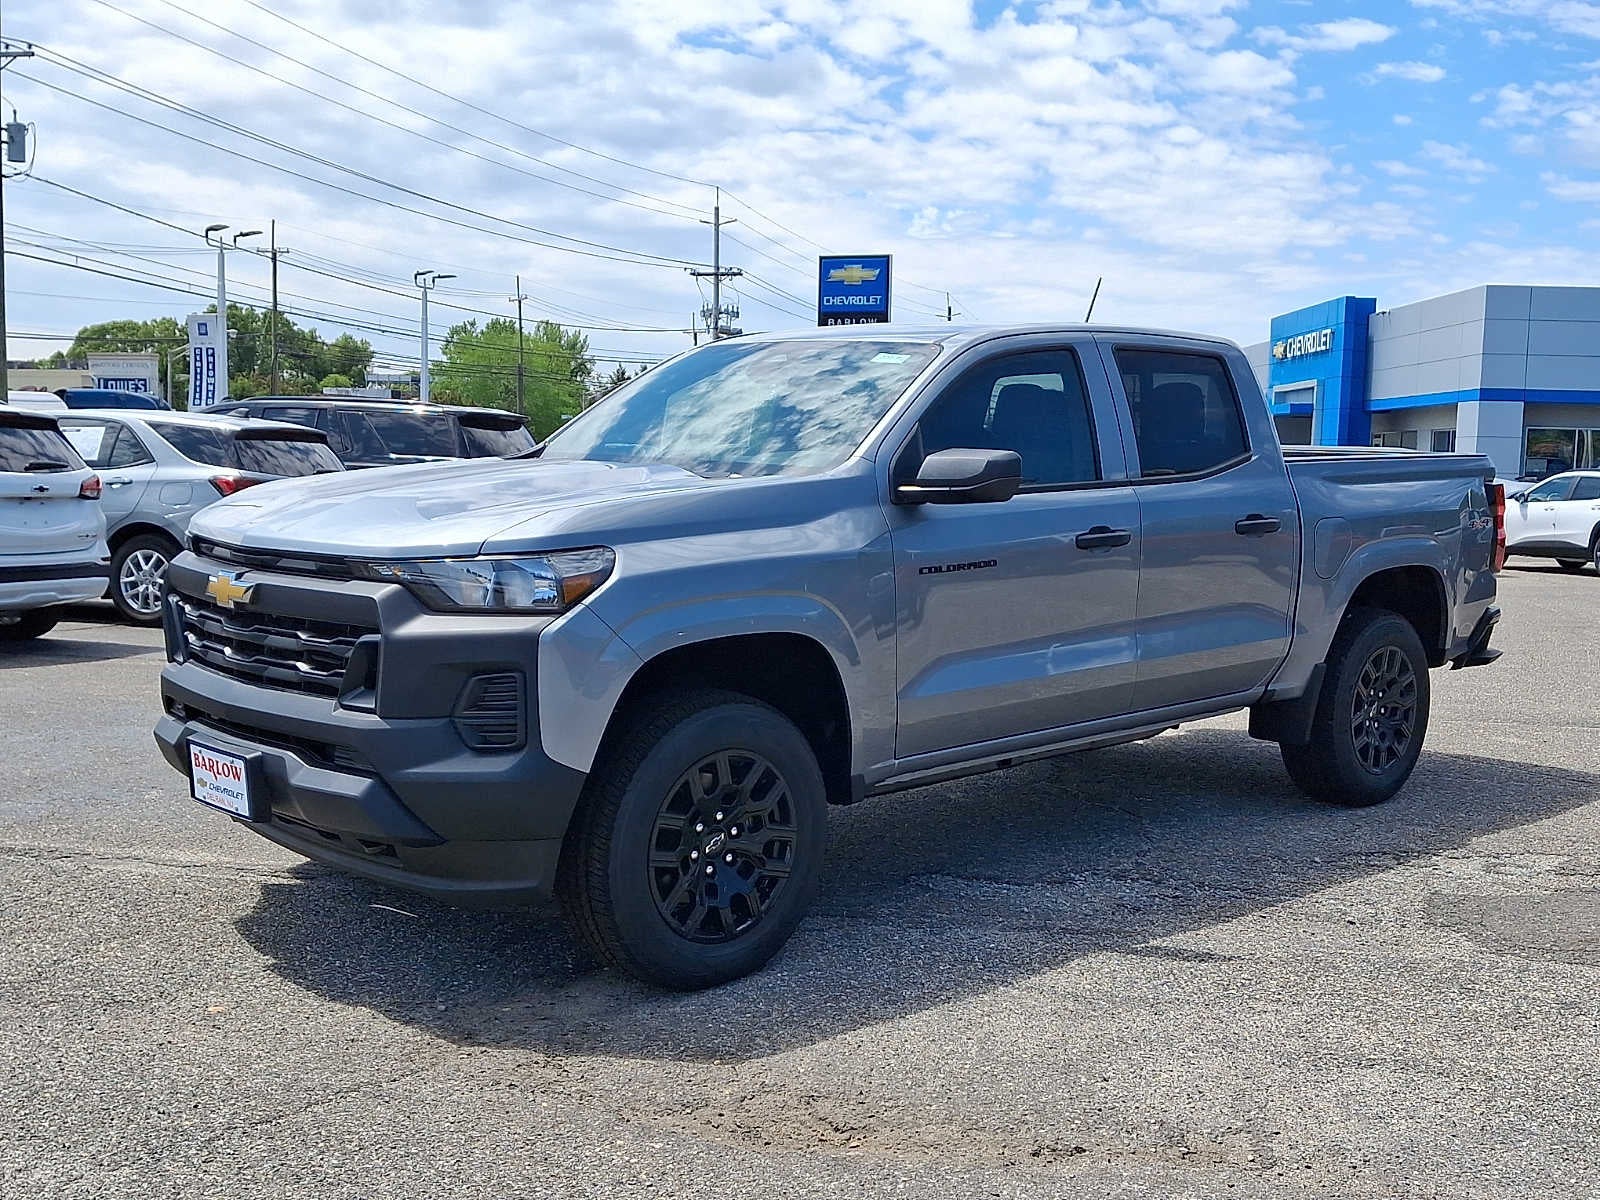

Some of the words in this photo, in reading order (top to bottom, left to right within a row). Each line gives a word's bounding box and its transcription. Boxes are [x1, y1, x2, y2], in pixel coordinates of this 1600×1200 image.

[823, 295, 882, 305] CHEVROLET
[827, 318, 878, 326] BARLOW
[1286, 328, 1332, 357] CHEVROLET
[99, 379, 145, 392] LOWE'S
[919, 559, 998, 575] COLORADO
[193, 752, 242, 782] BARLOW
[208, 782, 245, 800] CHEVROLET
